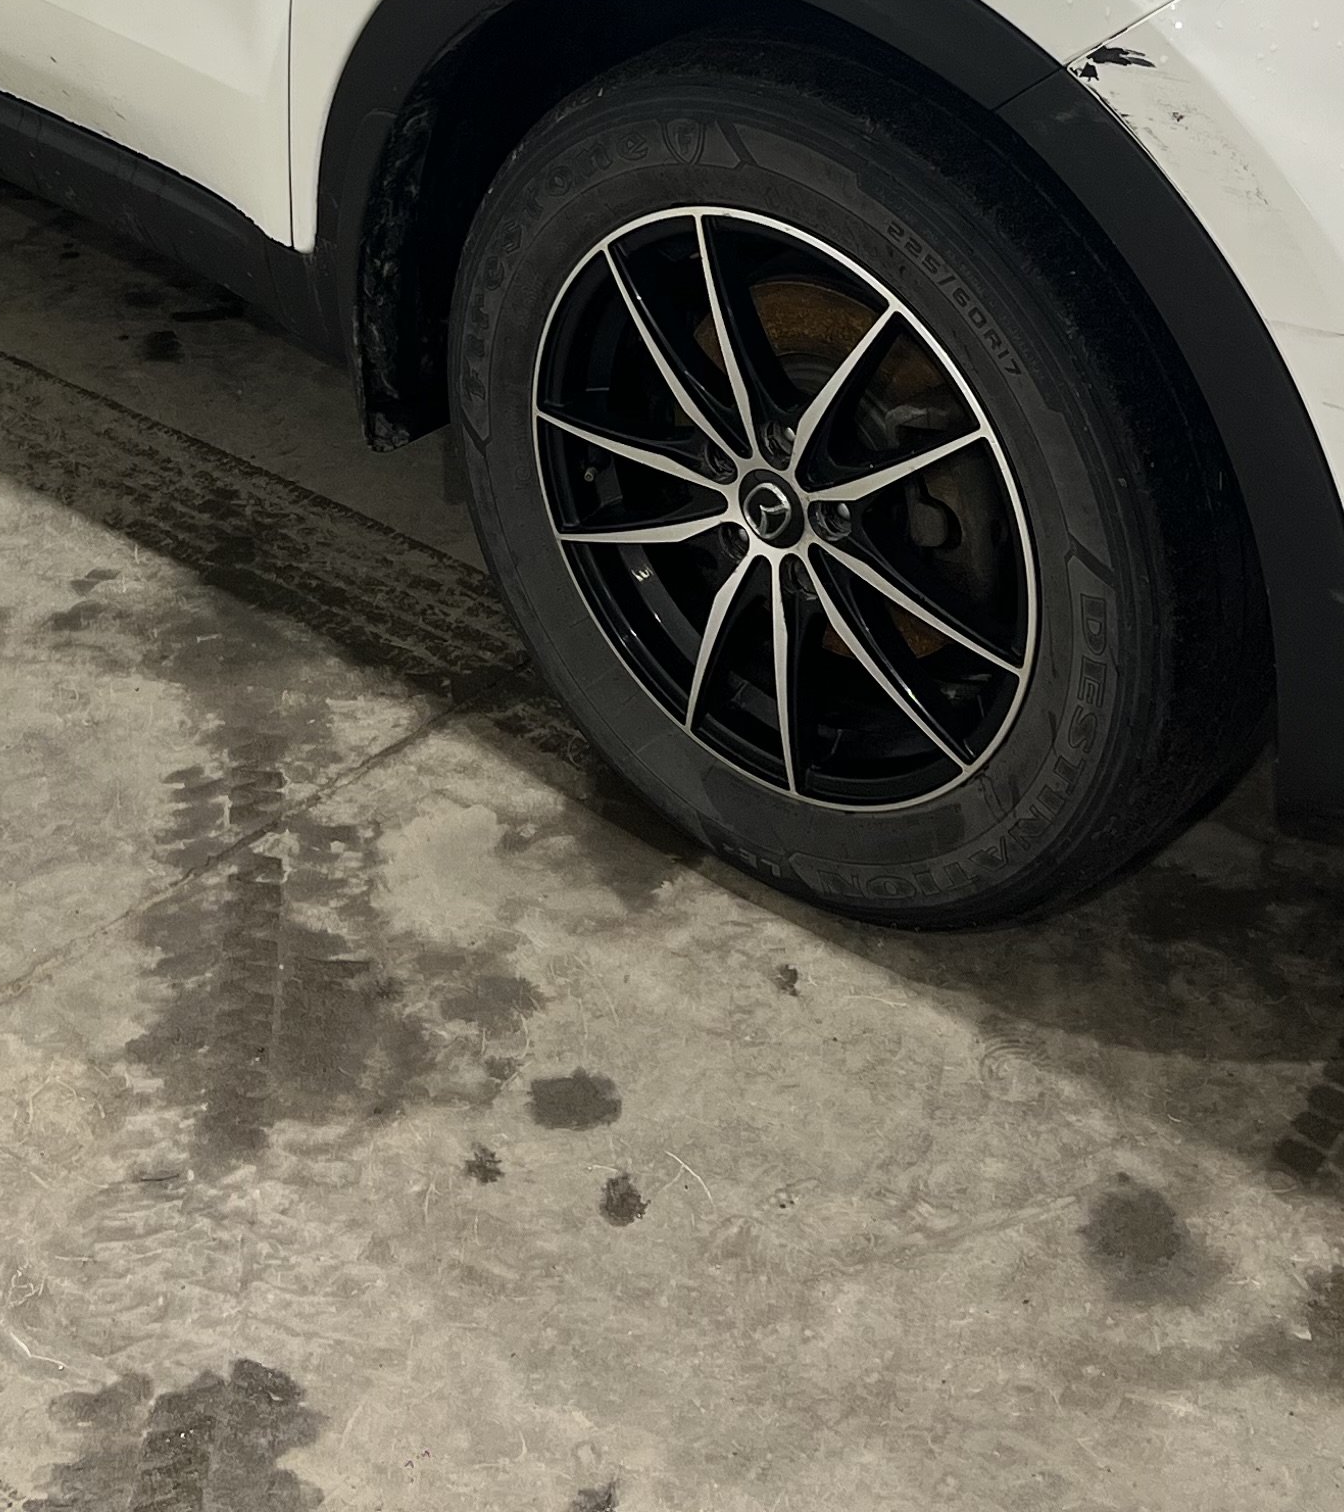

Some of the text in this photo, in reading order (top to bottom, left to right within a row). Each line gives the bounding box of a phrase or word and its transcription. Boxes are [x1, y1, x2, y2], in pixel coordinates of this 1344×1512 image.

[464, 134, 648, 400] Firestone
[887, 221, 1022, 376] 225/60R17
[817, 593, 1108, 900] DESTINATION
